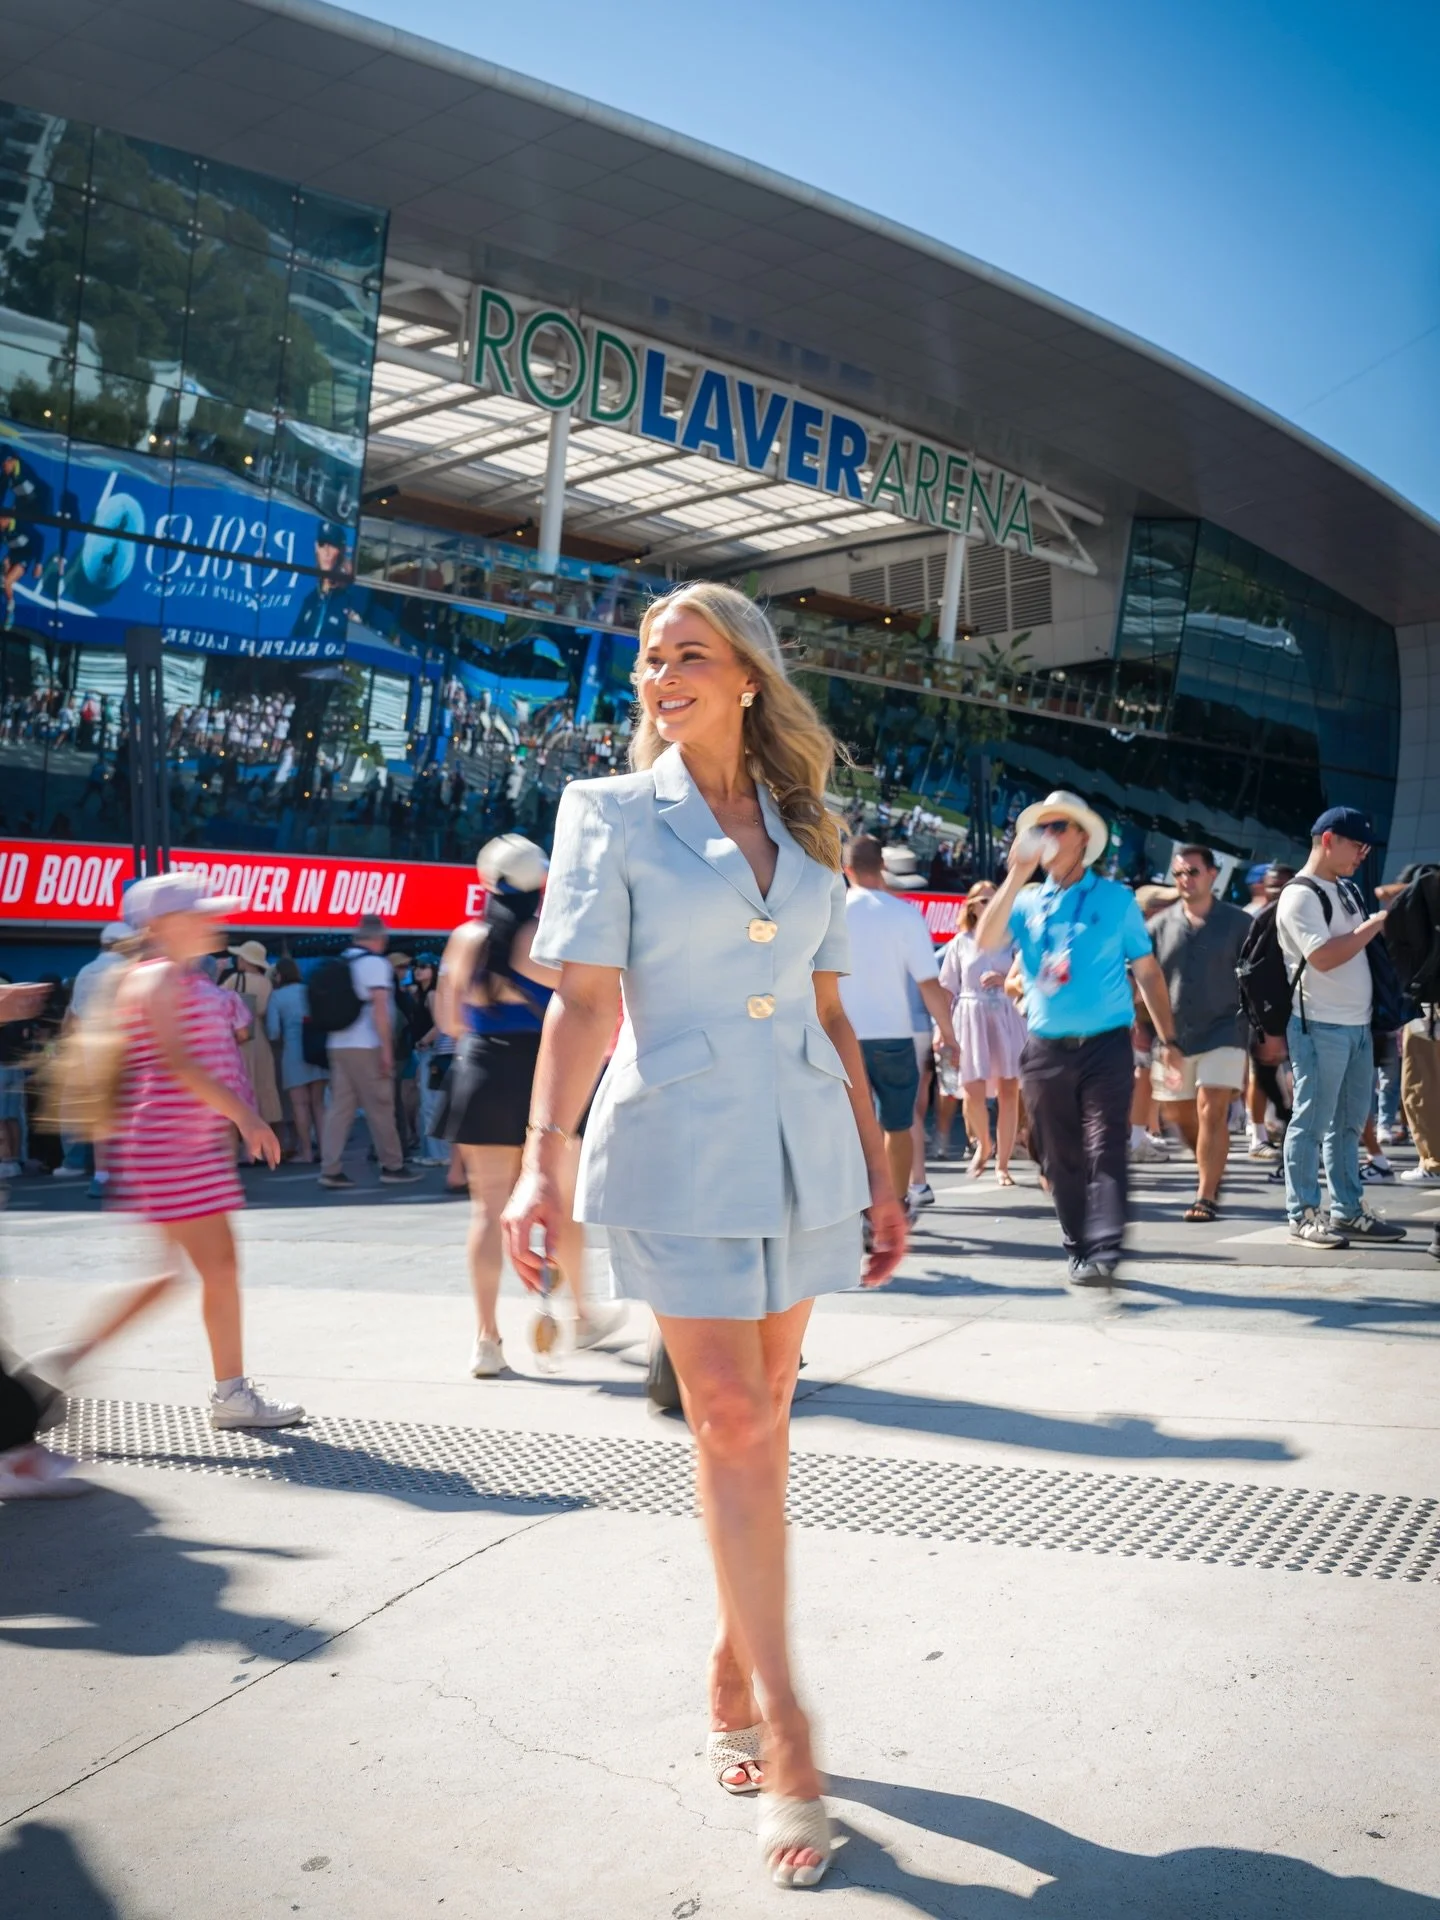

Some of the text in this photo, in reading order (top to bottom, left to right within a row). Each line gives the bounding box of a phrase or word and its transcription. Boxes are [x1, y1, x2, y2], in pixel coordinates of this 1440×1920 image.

[472, 288, 1034, 553] ROD LAVER ARENA
[35, 854, 124, 907] BOOK
[293, 868, 326, 913] IN
[328, 870, 406, 916] DUBAI
